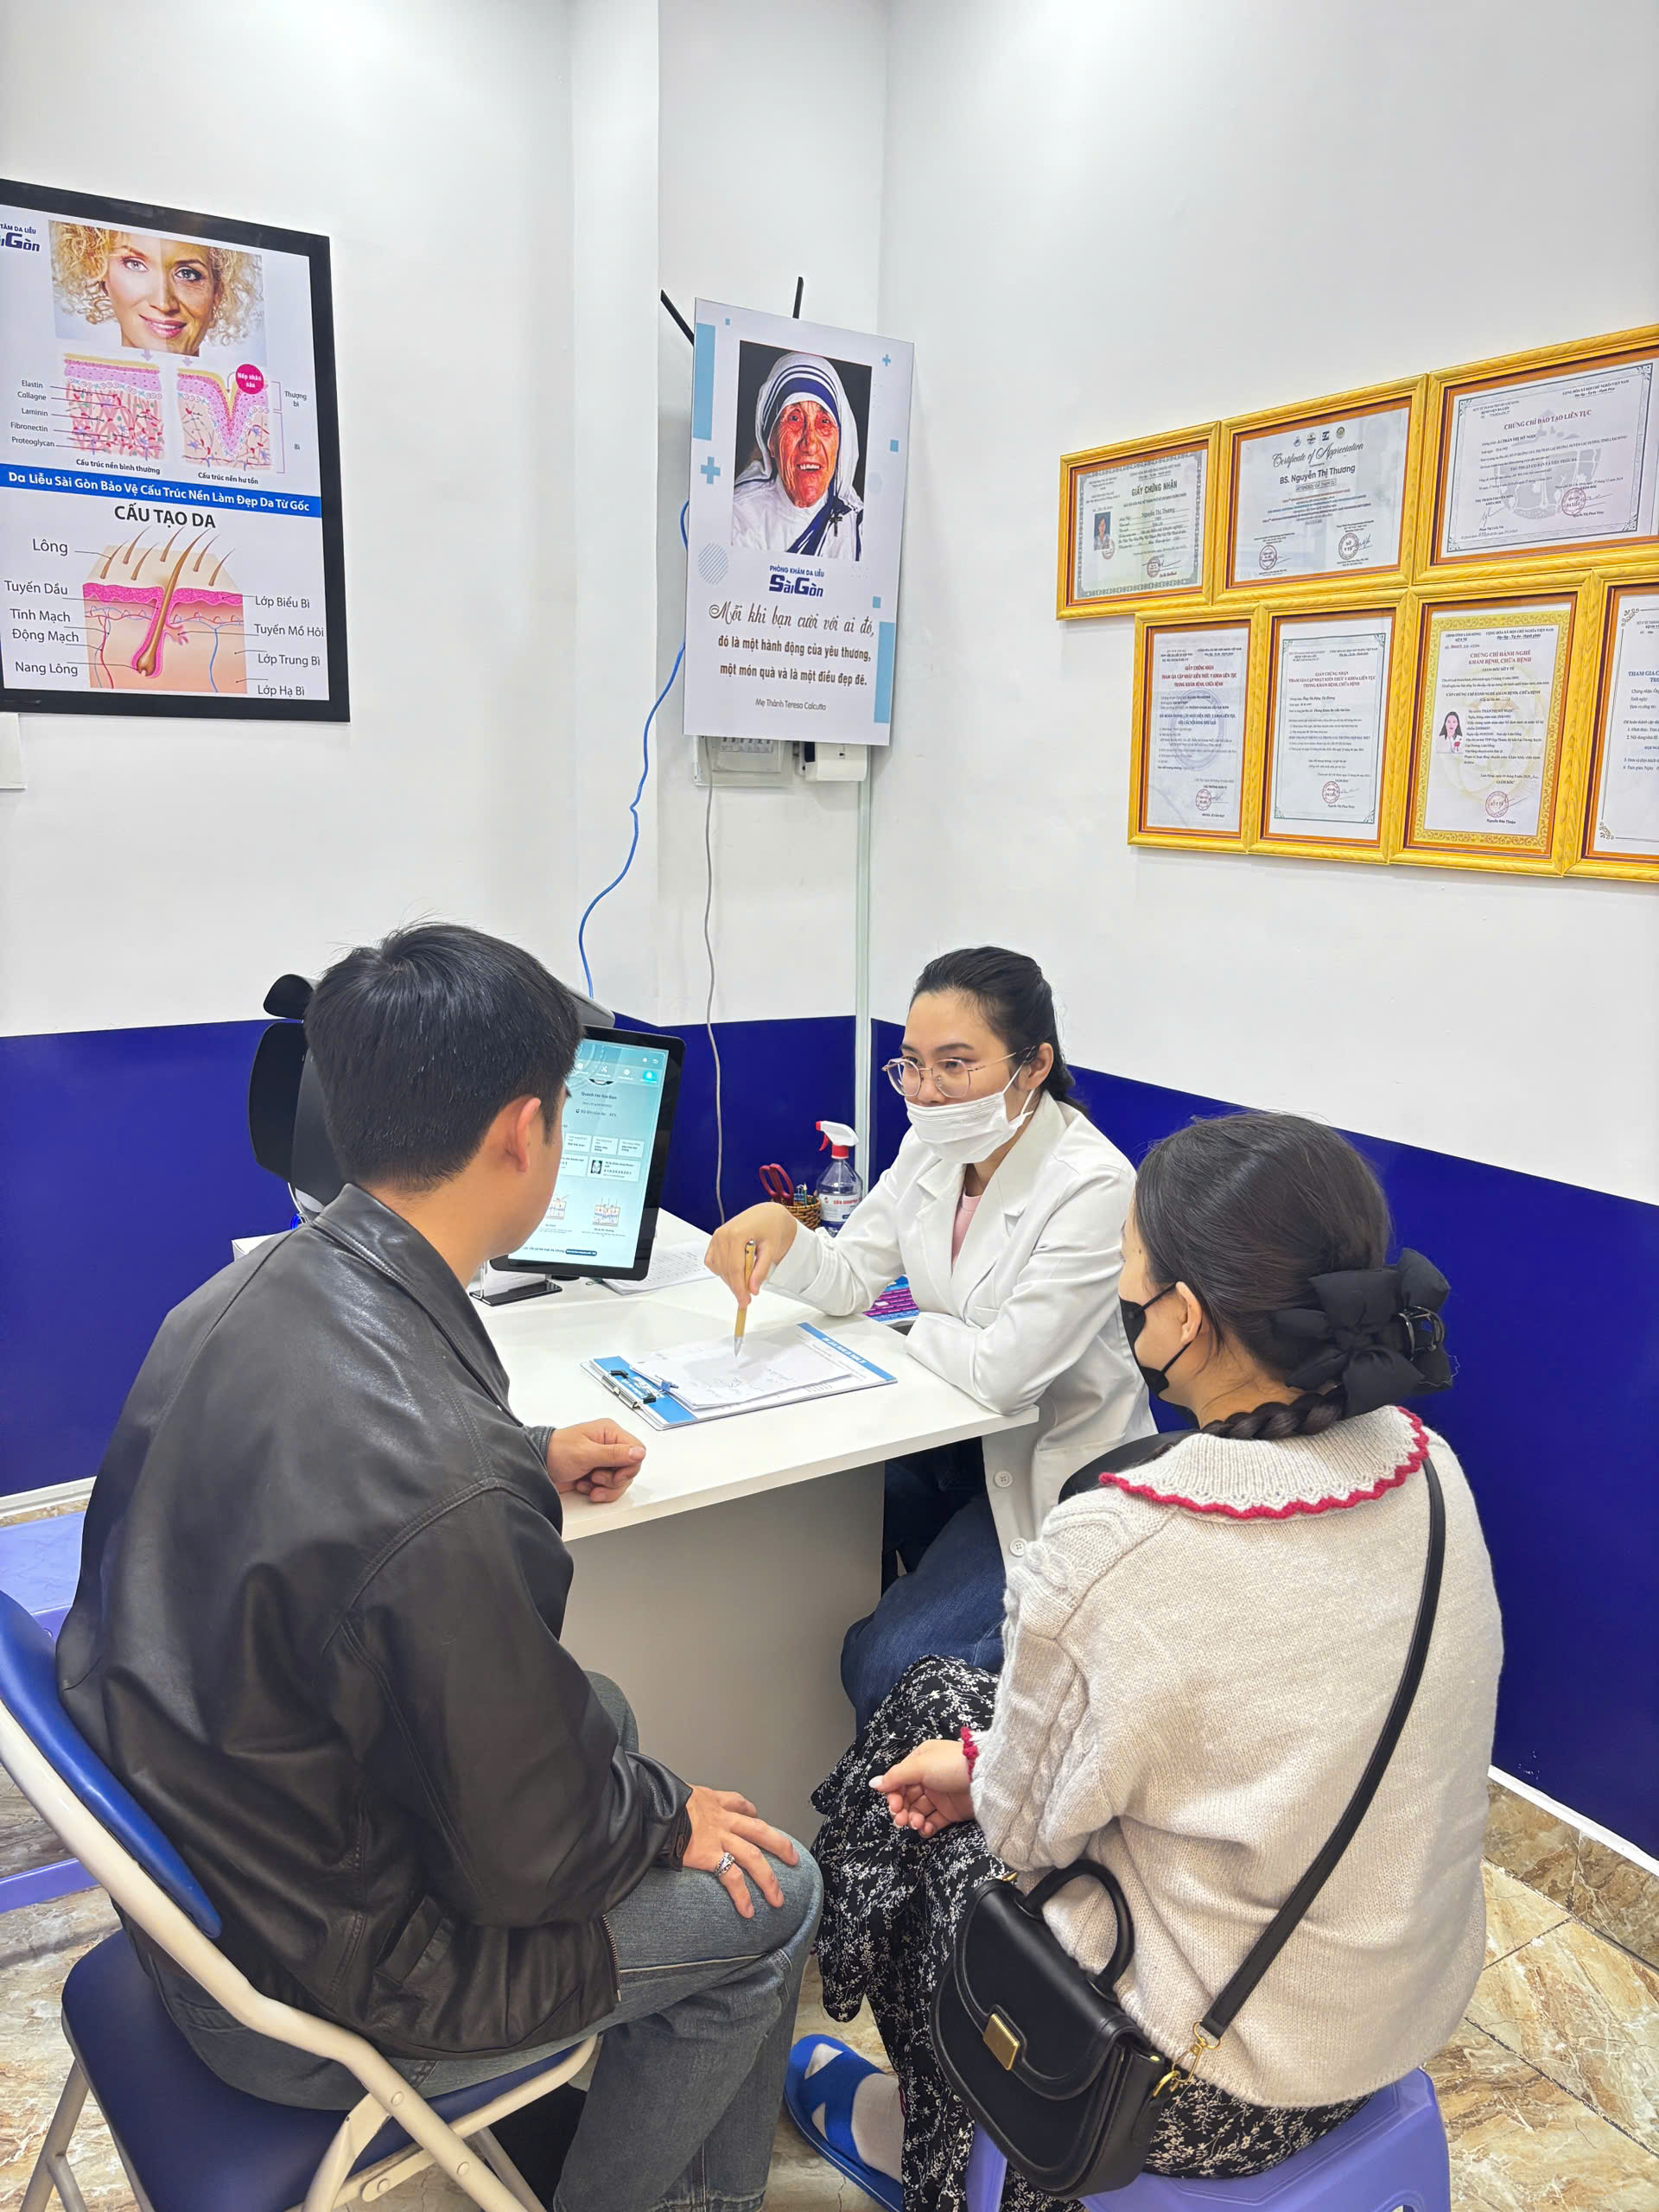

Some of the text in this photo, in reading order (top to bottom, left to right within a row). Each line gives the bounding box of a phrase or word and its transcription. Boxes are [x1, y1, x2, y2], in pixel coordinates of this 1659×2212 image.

[0, 232, 40, 251] iGòn
[22, 380, 43, 389] Elastin
[18, 391, 47, 401] Collagne
[285, 391, 307, 400] Thượng
[22, 408, 48, 416] Laminin
[10, 422, 48, 432] Fibronectin
[12, 436, 55, 448] Proteoglycan
[1307, 449, 1315, 464] of
[76, 458, 89, 467] Cấu
[119, 463, 135, 471] bình
[136, 465, 160, 475] thường
[1280, 476, 1290, 484] BS.
[1291, 470, 1316, 483] Nguyễn
[1318, 468, 1328, 478] Thị
[9, 472, 310, 511] Da Liễu Sài Gòn Bảo Vệ Cấu Trúc Nền Làm Đẹp Da Từ Gốc
[114, 502, 216, 528] CẤU TẠO DA
[33, 538, 68, 556] Lông
[769, 565, 788, 573] PHÒNG
[4, 580, 68, 595] Tuyến Dầu
[769, 574, 823, 597] SàiGòn
[255, 596, 310, 608] Lớp Biểu Bì
[39, 610, 71, 624] Mạch
[709, 601, 874, 636] Mỗi khi bạn cười với ai đó,
[12, 628, 79, 643] Động Mạch
[254, 624, 324, 637] Tuyến Mồ Hôi
[718, 635, 871, 662] đó là một hành động của yêu thương,
[258, 653, 320, 667] Lớp Trung Bì
[16, 662, 78, 677] Nang Lông
[720, 663, 736, 677] một
[739, 664, 757, 676] món
[760, 666, 775, 680] quà
[778, 667, 787, 679] và
[790, 668, 798, 680] là
[801, 670, 816, 683] một
[818, 670, 835, 683] điều
[838, 673, 852, 686] đẹp
[258, 685, 305, 697] Lớp Hạ Bì
